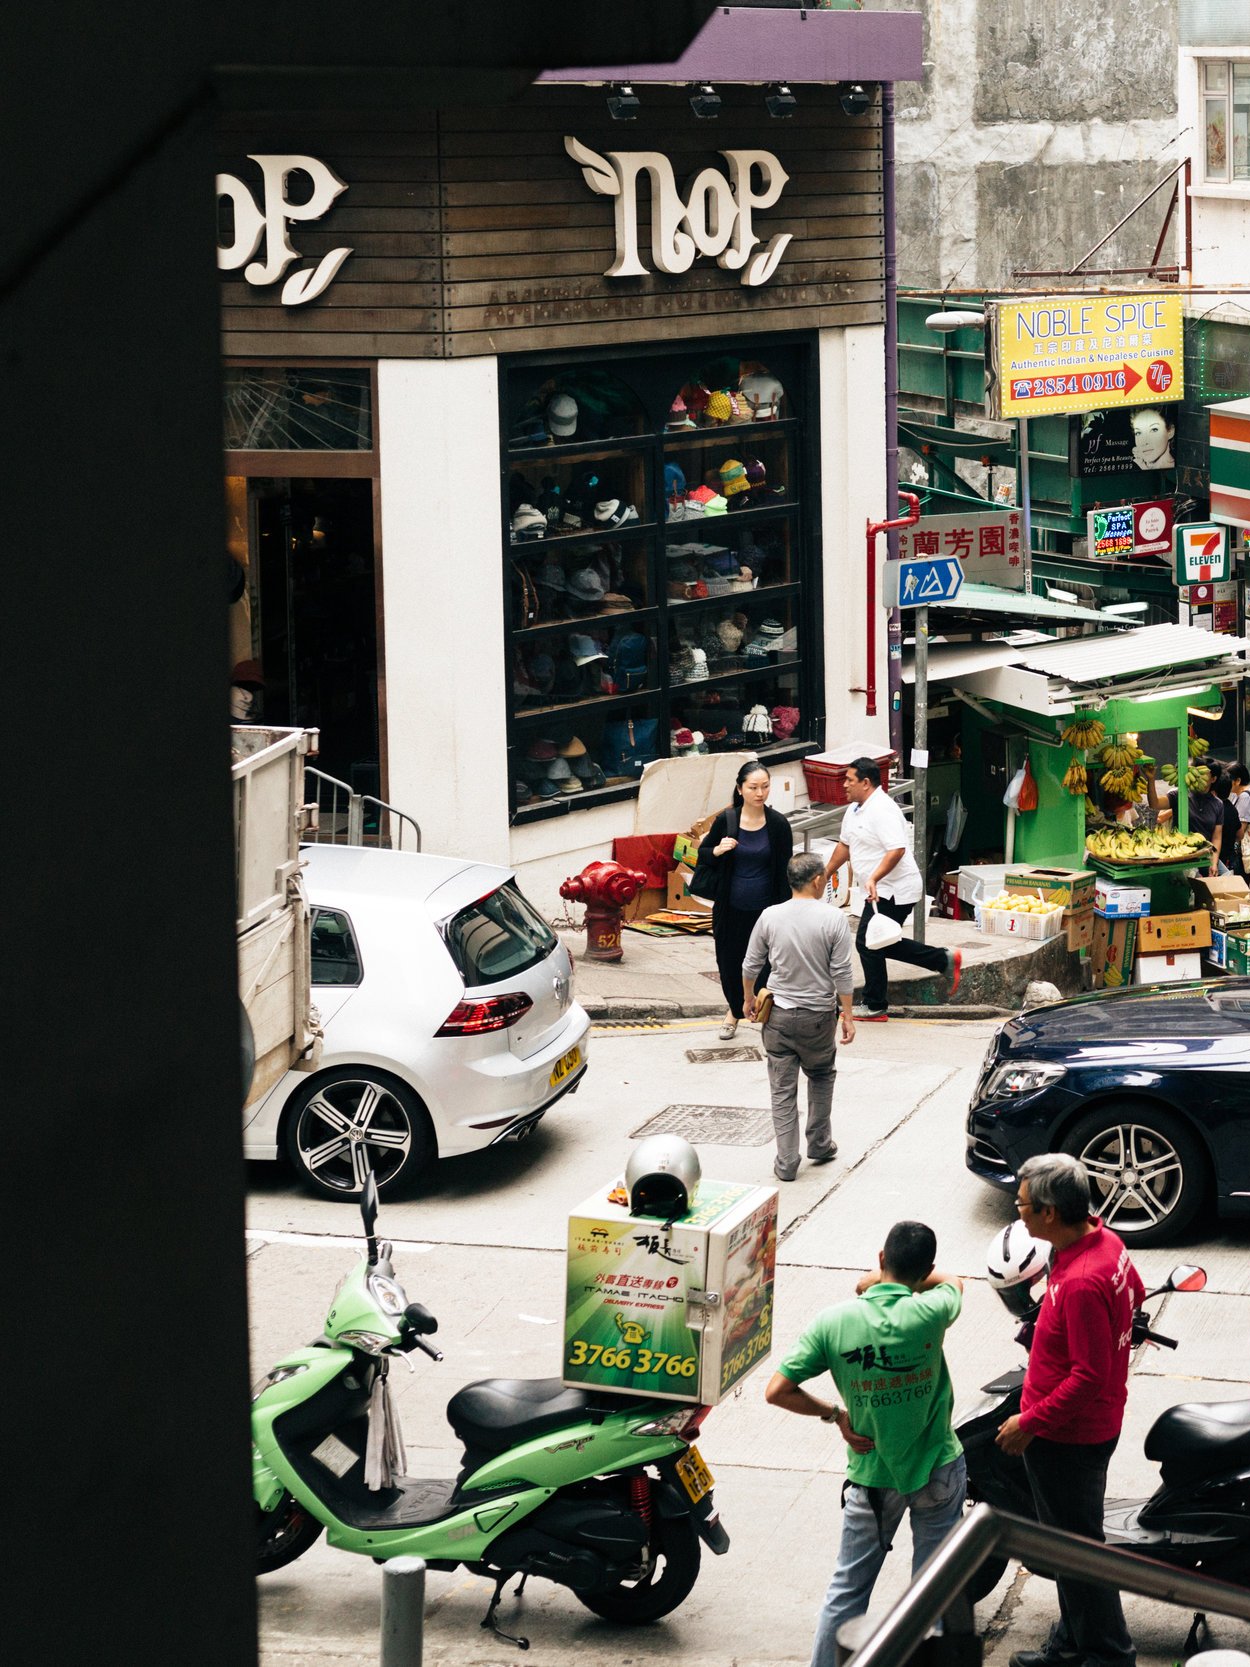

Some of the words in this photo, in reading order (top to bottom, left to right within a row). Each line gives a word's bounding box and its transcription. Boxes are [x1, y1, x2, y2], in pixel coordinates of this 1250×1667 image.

[1017, 307, 1093, 339] NOBLE
[1105, 300, 1166, 333] SPICE
[1011, 358, 1056, 370] Authentic
[1057, 356, 1086, 365] Indian
[1088, 355, 1095, 363] &
[1097, 352, 1138, 363] Nepalese
[1140, 348, 1174, 358] Cuisine
[1034, 375, 1078, 395] 2854
[1082, 371, 1126, 393] 0916
[1105, 439, 1128, 447] Massage
[1111, 522, 1127, 530] SPA
[1029, 879, 1051, 887] BANANAS
[584, 1286, 630, 1297] ITAMAE
[637, 1292, 684, 1303] ITACHO
[603, 1298, 634, 1307] DELIVERY
[634, 1301, 665, 1310] EXPRESS
[568, 1340, 631, 1370] 3766
[632, 1349, 696, 1377] 3766
[720, 1352, 745, 1389] 3766
[744, 1328, 771, 1366] 3766
[853, 1380, 932, 1408] 37663766
